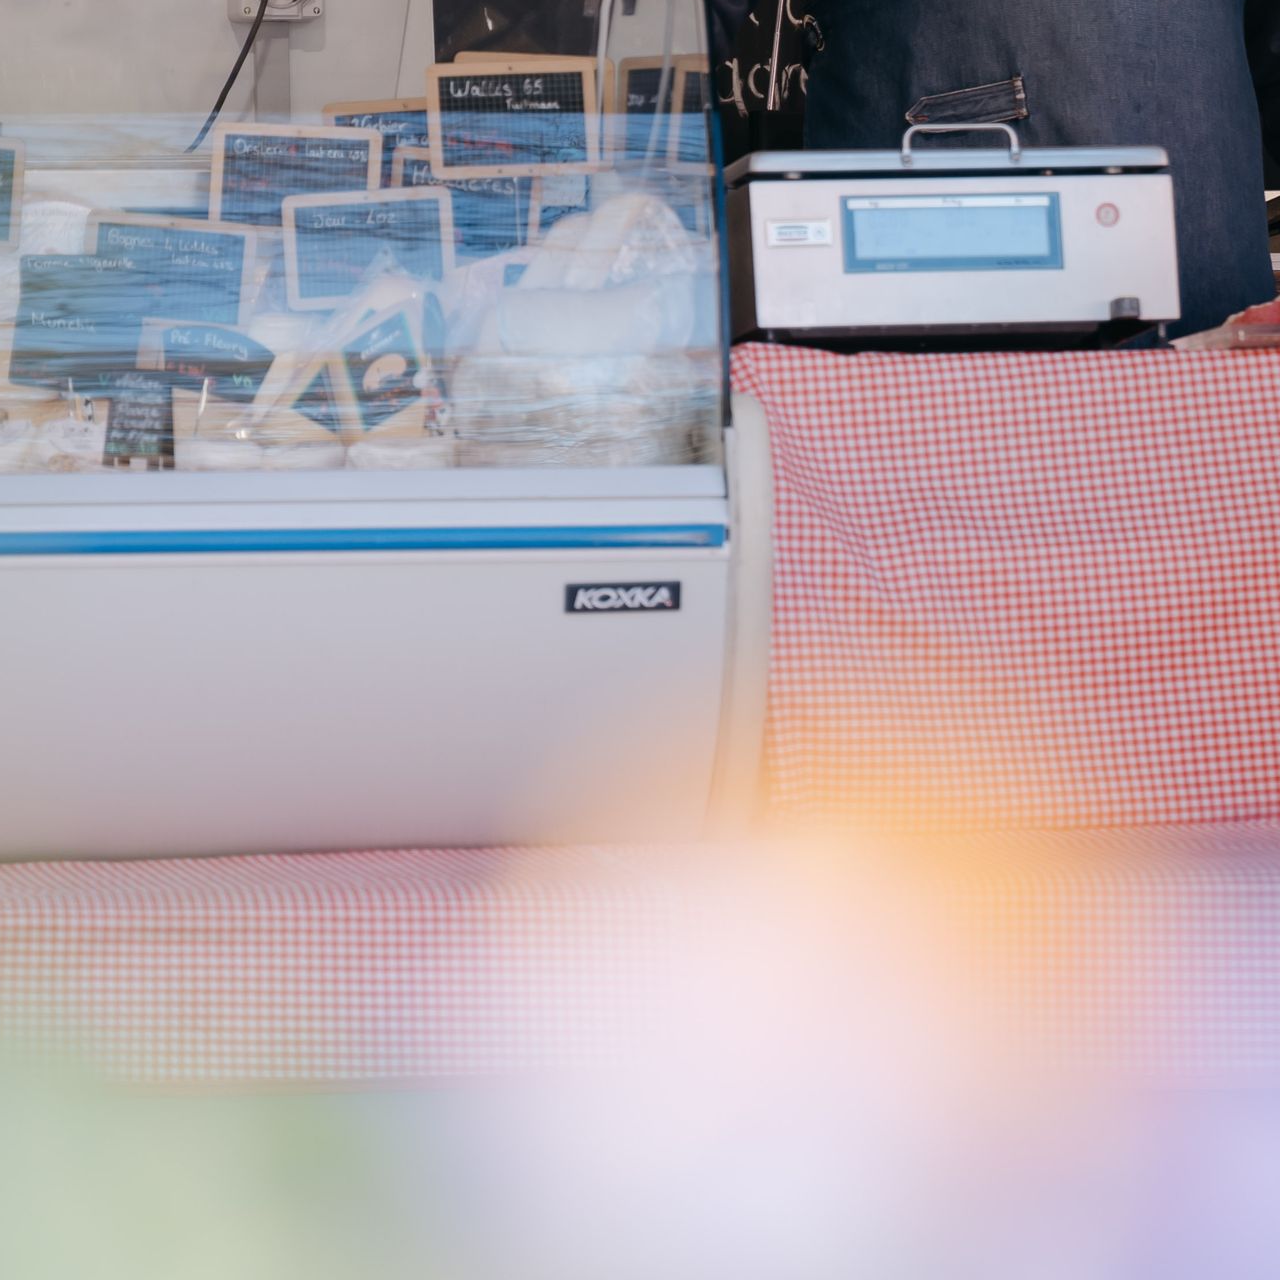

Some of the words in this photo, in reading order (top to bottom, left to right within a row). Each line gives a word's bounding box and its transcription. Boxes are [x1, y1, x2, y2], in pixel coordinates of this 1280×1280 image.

[449, 79, 514, 97] Wallis
[522, 79, 544, 95] 65
[573, 586, 671, 610] KOXKA
